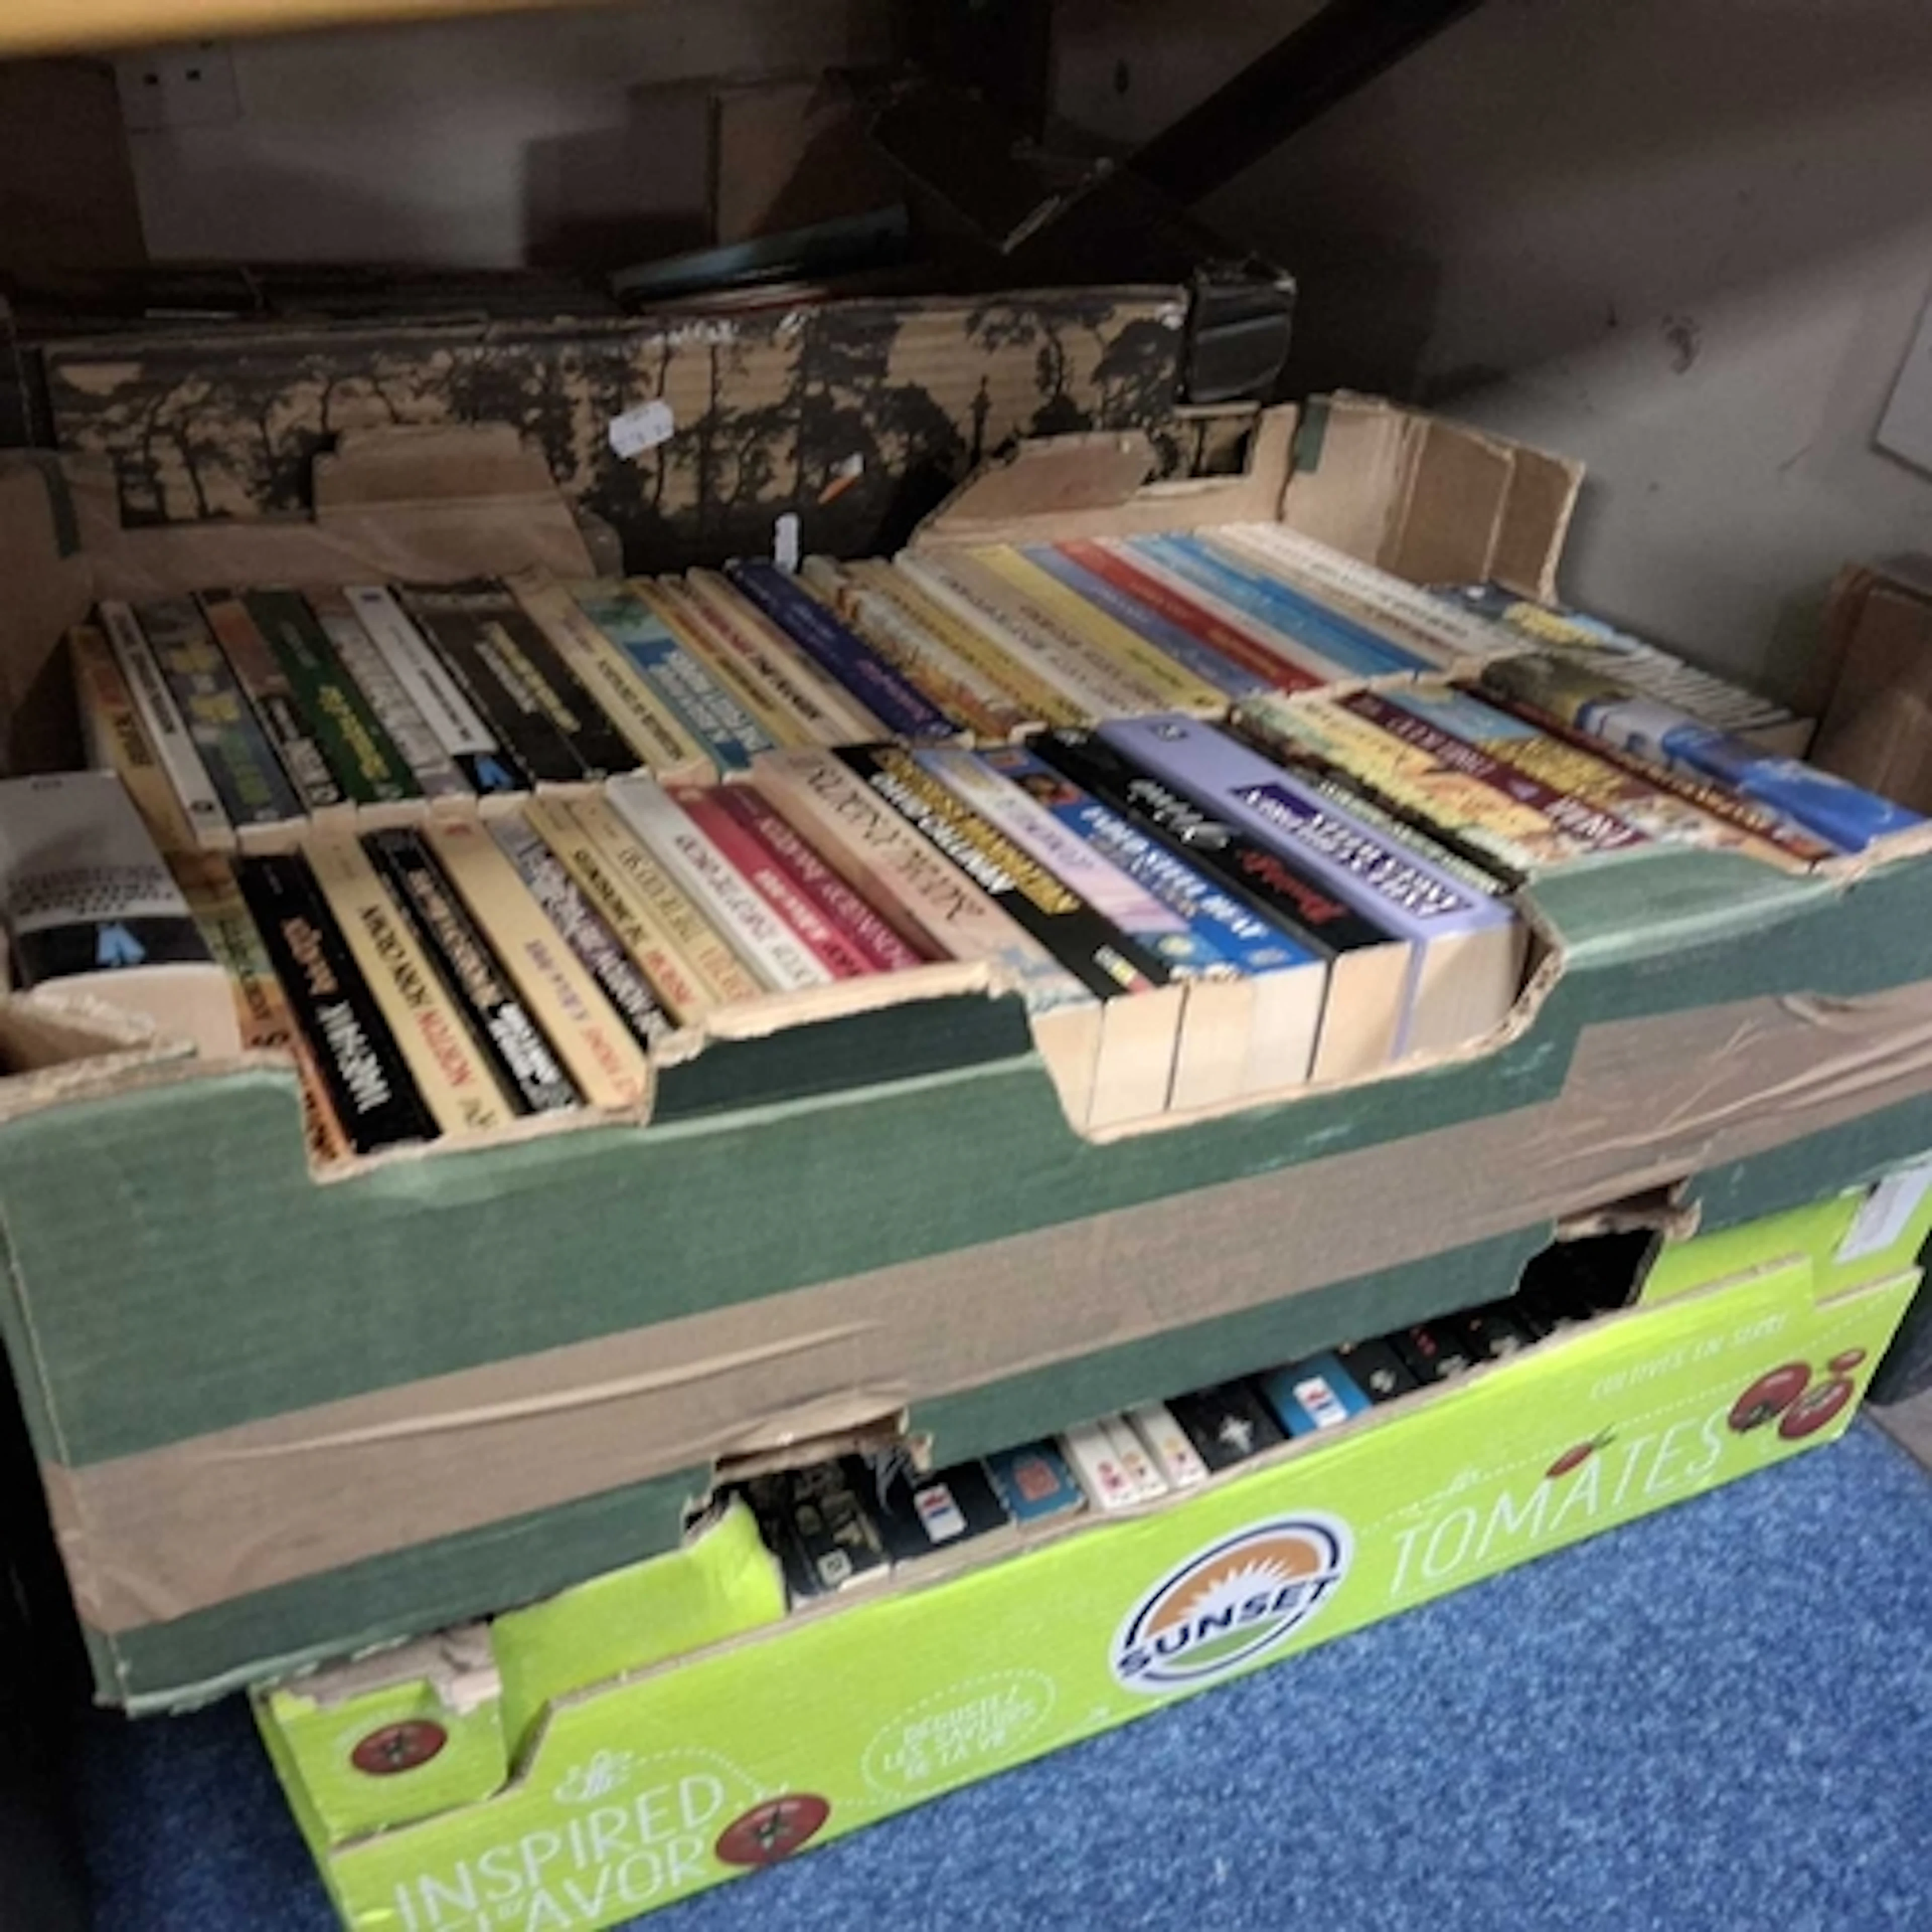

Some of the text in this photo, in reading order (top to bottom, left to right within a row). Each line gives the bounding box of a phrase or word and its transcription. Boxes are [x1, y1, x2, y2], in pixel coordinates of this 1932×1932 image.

[1391, 1406, 1731, 1594] TOMATES
[1117, 1573, 1340, 1679] SUNSET
[394, 1774, 724, 1932] INSPIRED
